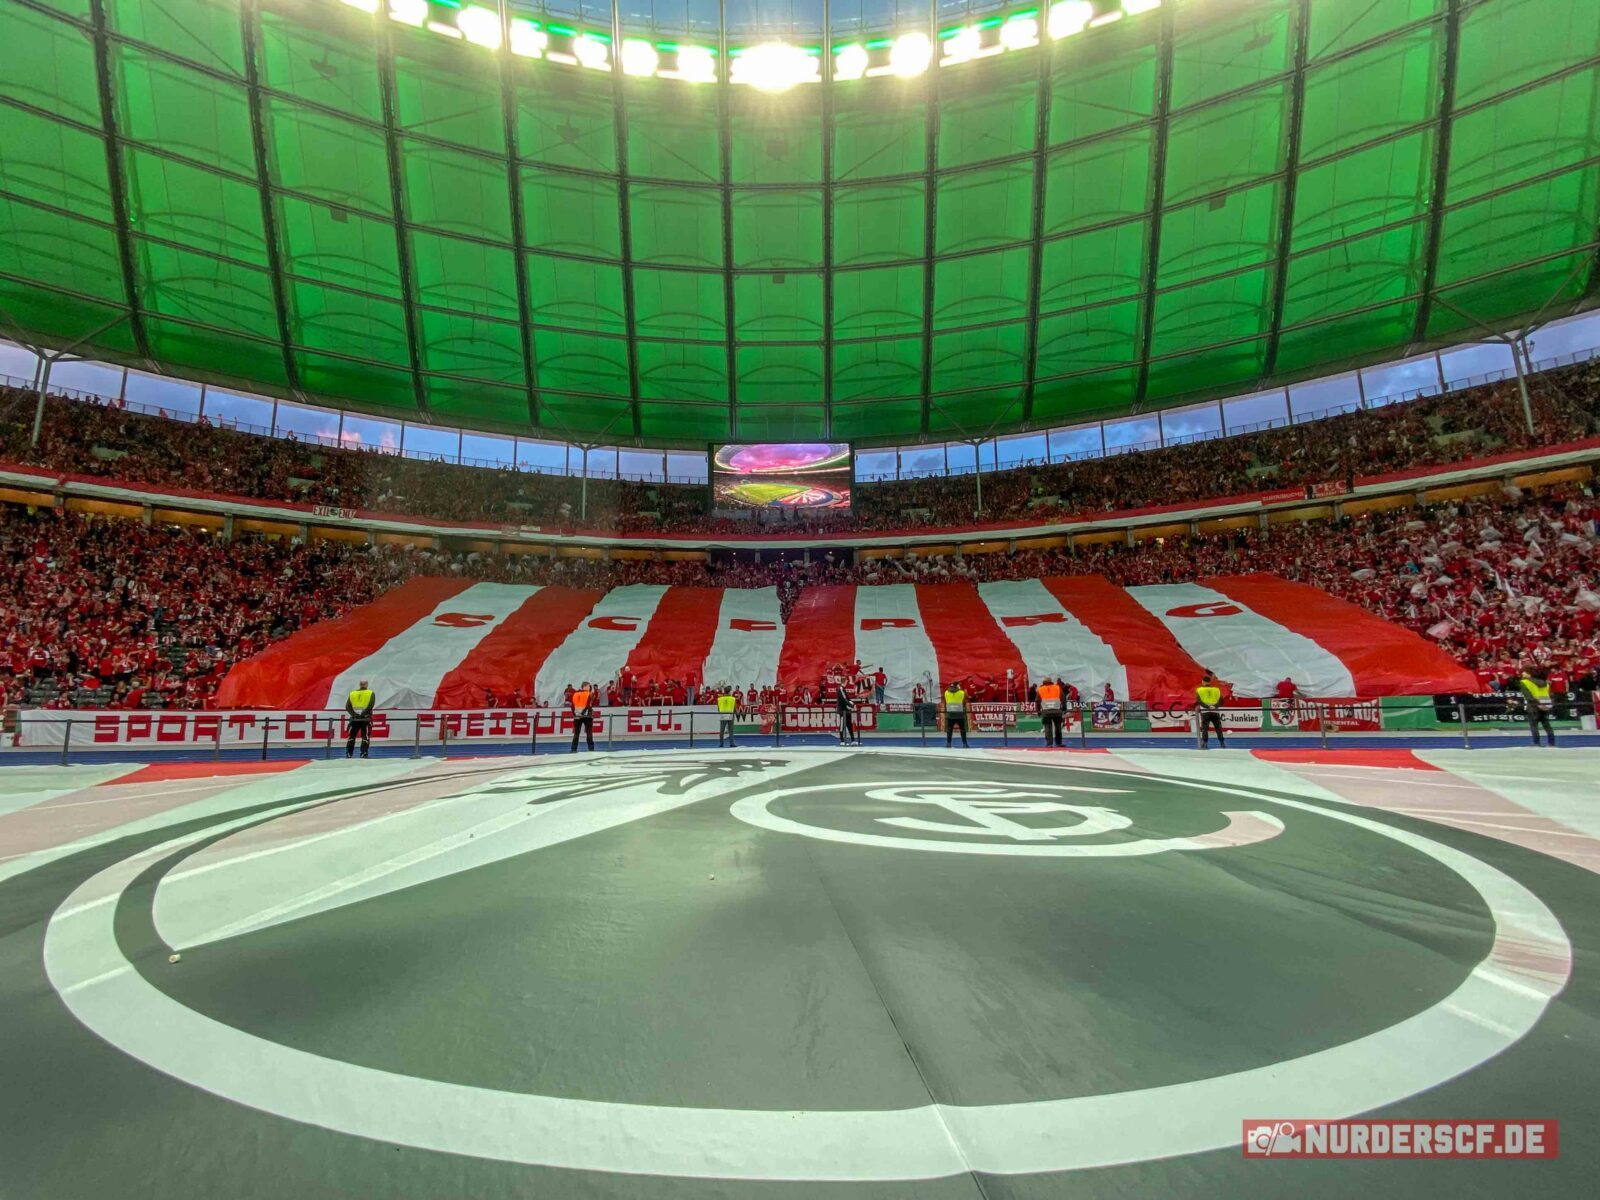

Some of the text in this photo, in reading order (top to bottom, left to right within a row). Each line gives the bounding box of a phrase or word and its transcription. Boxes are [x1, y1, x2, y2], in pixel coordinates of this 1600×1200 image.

[785, 707, 873, 727] CORRO
[975, 713, 1004, 721] ULTRAS
[1220, 713, 1259, 722] C-Junkies
[1299, 699, 1379, 723] ROTE HORDE
